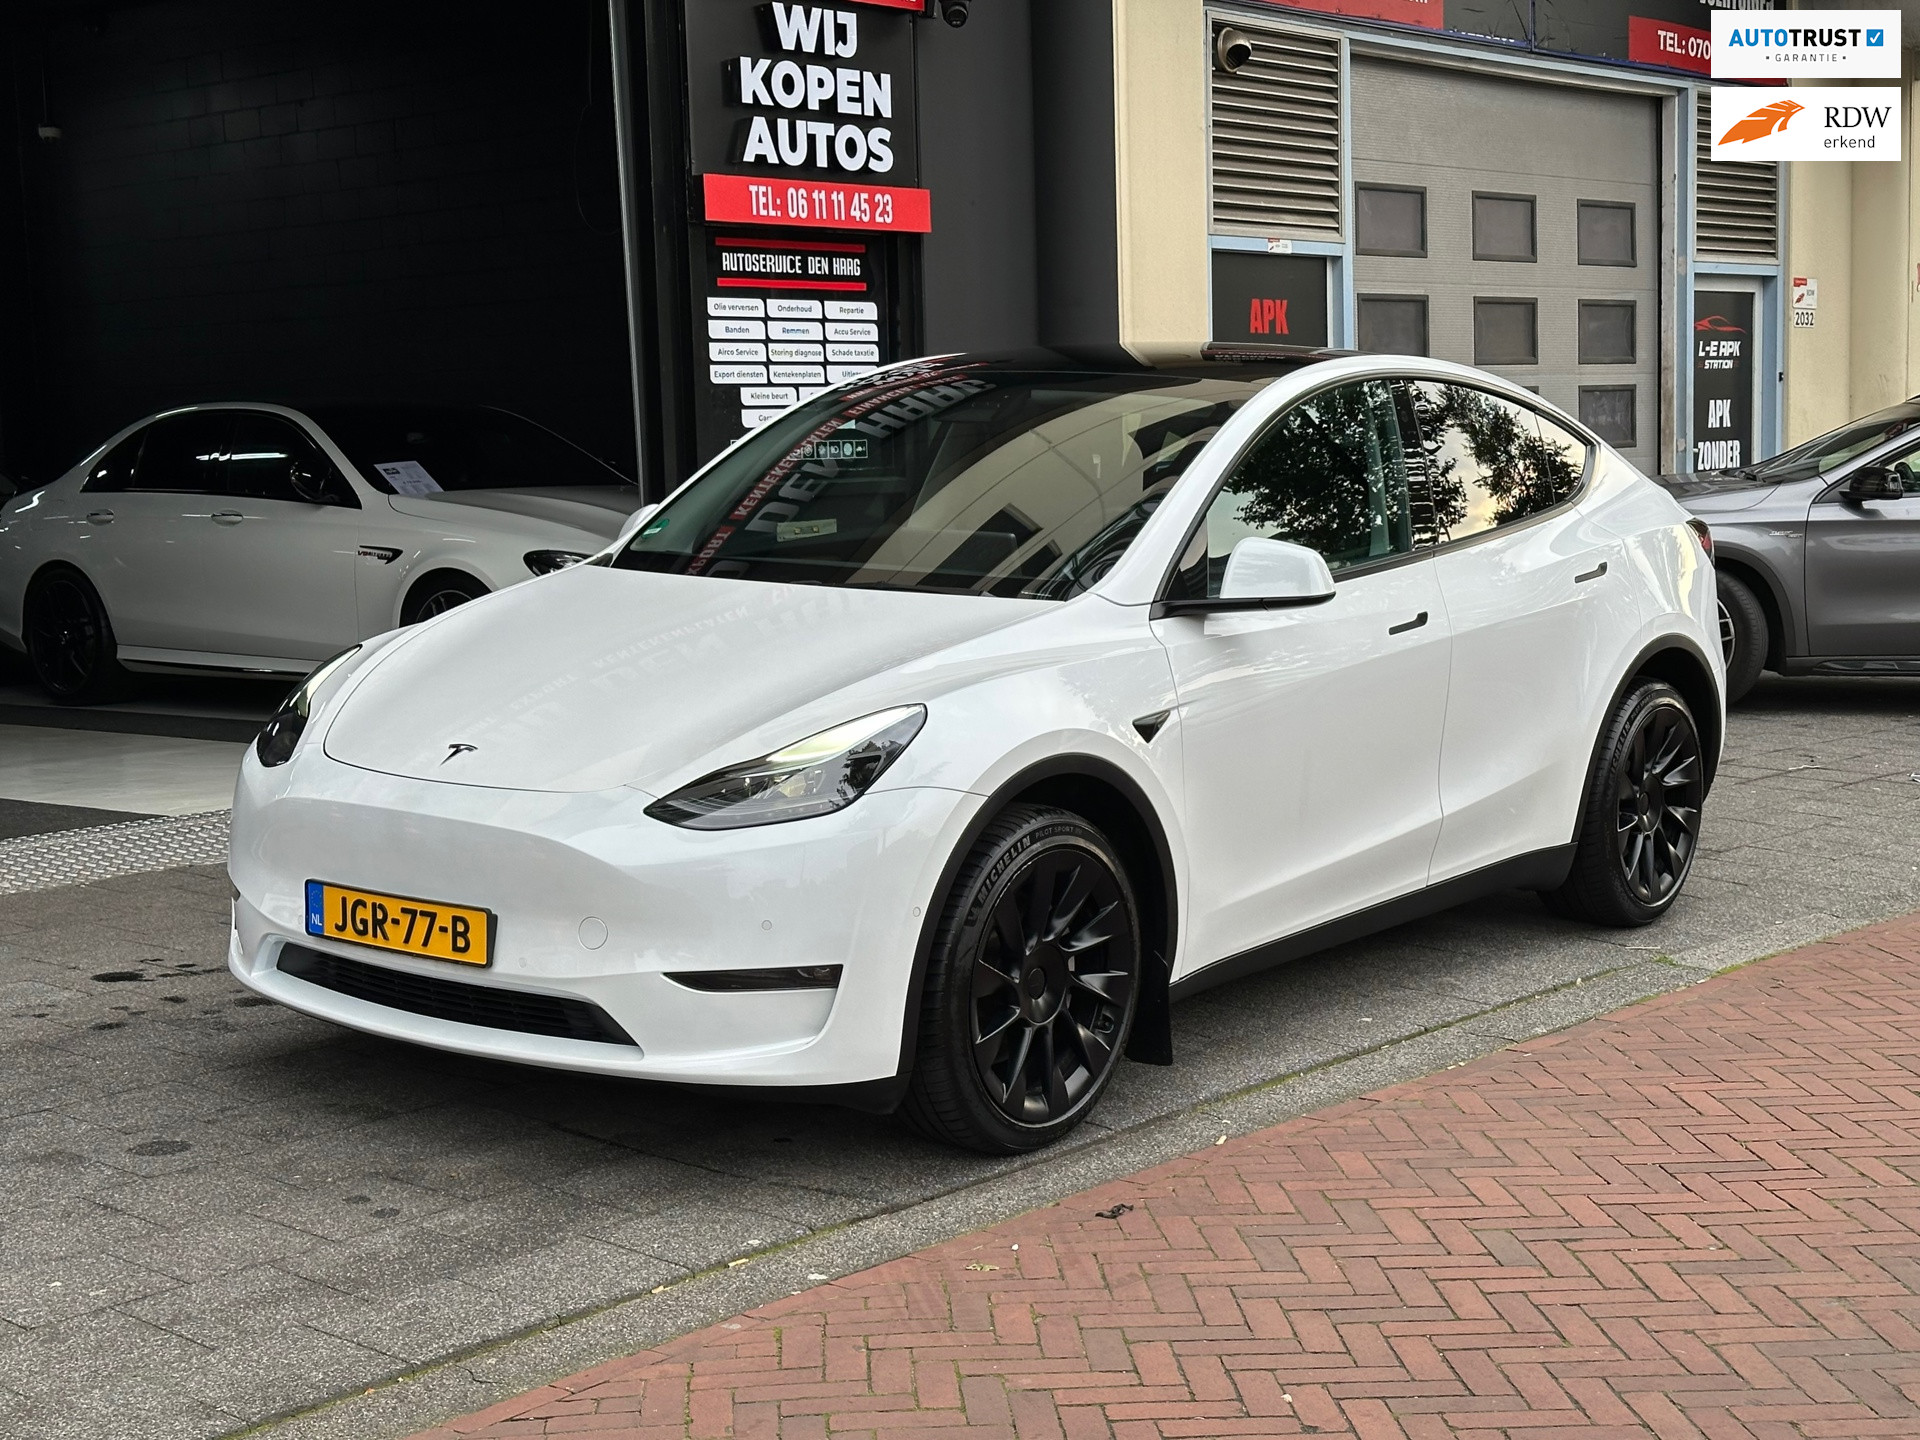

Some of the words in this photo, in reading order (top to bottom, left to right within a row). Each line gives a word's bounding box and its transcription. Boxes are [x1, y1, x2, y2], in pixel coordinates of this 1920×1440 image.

[772, 2, 857, 58] WIJ
[1657, 29, 1686, 55] TEL:
[739, 56, 892, 118] KOPEN
[743, 115, 894, 173] AUTOS
[749, 184, 781, 217] TEL:
[787, 187, 808, 219] 06
[812, 189, 827, 220] 11
[831, 190, 846, 221] 11
[850, 192, 870, 223] 45
[874, 193, 893, 224] 23
[722, 252, 802, 274] AUTOSERVICE
[808, 256, 829, 275] DEN
[833, 257, 861, 276] HAAG
[777, 304, 812, 312] Onderhoud
[1249, 298, 1289, 334] APK
[1795, 311, 1814, 326] 2032
[725, 326, 750, 334] Banden
[782, 327, 810, 335] Remmen
[771, 349, 794, 357] Storing
[794, 348, 822, 357] diagnose
[1719, 341, 1741, 357] APK
[714, 371, 735, 379] Export
[773, 371, 821, 379] Kentekenplaten
[1704, 359, 1734, 369] STATION
[1707, 399, 1732, 428] APK
[1697, 439, 1741, 471] ZONDER
[977, 835, 1031, 904] MICHELIN
[311, 913, 323, 926] NL
[334, 896, 471, 954] JGR-77-B
